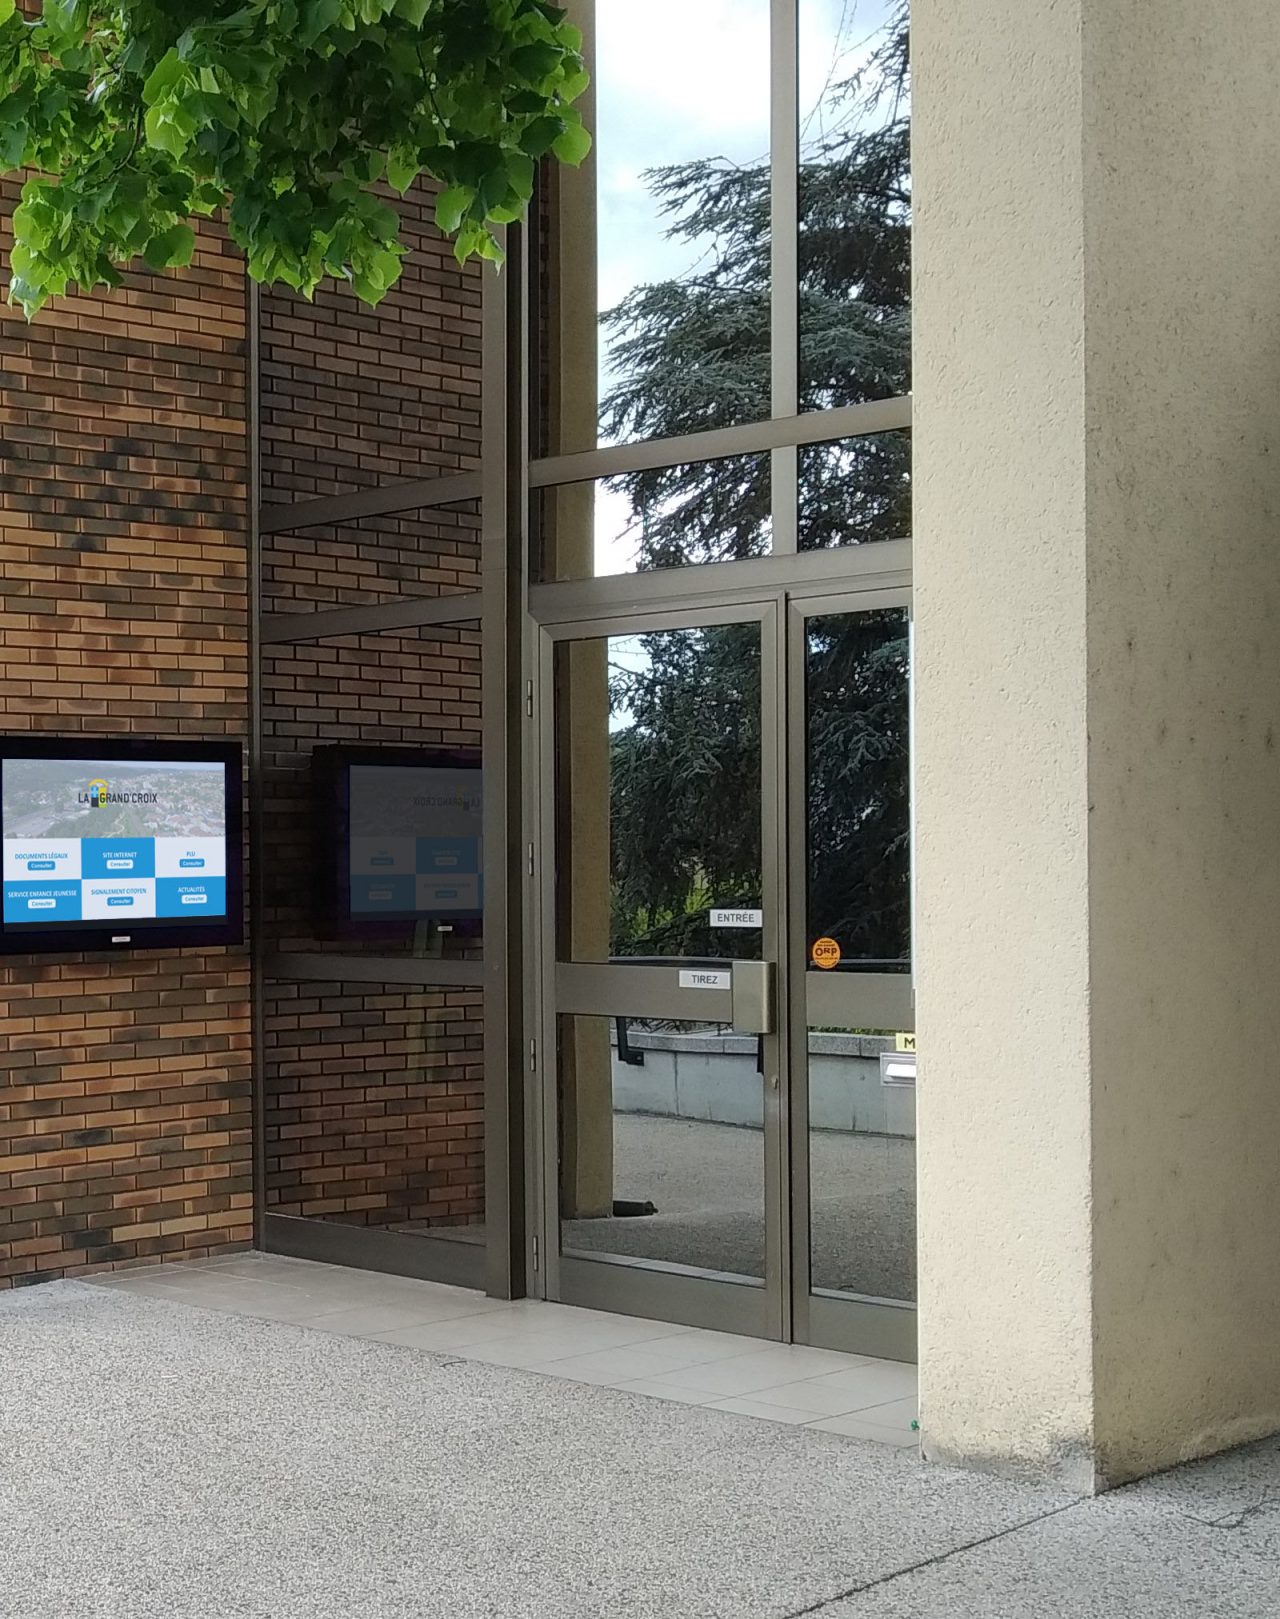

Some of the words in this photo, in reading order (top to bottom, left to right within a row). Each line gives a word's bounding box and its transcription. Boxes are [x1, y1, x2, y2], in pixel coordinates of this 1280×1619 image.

[78, 793, 89, 803] LA
[100, 793, 157, 803] GRAND'CROIX
[717, 912, 754, 923] ENTRÉE
[692, 975, 718, 984] TIREZ
